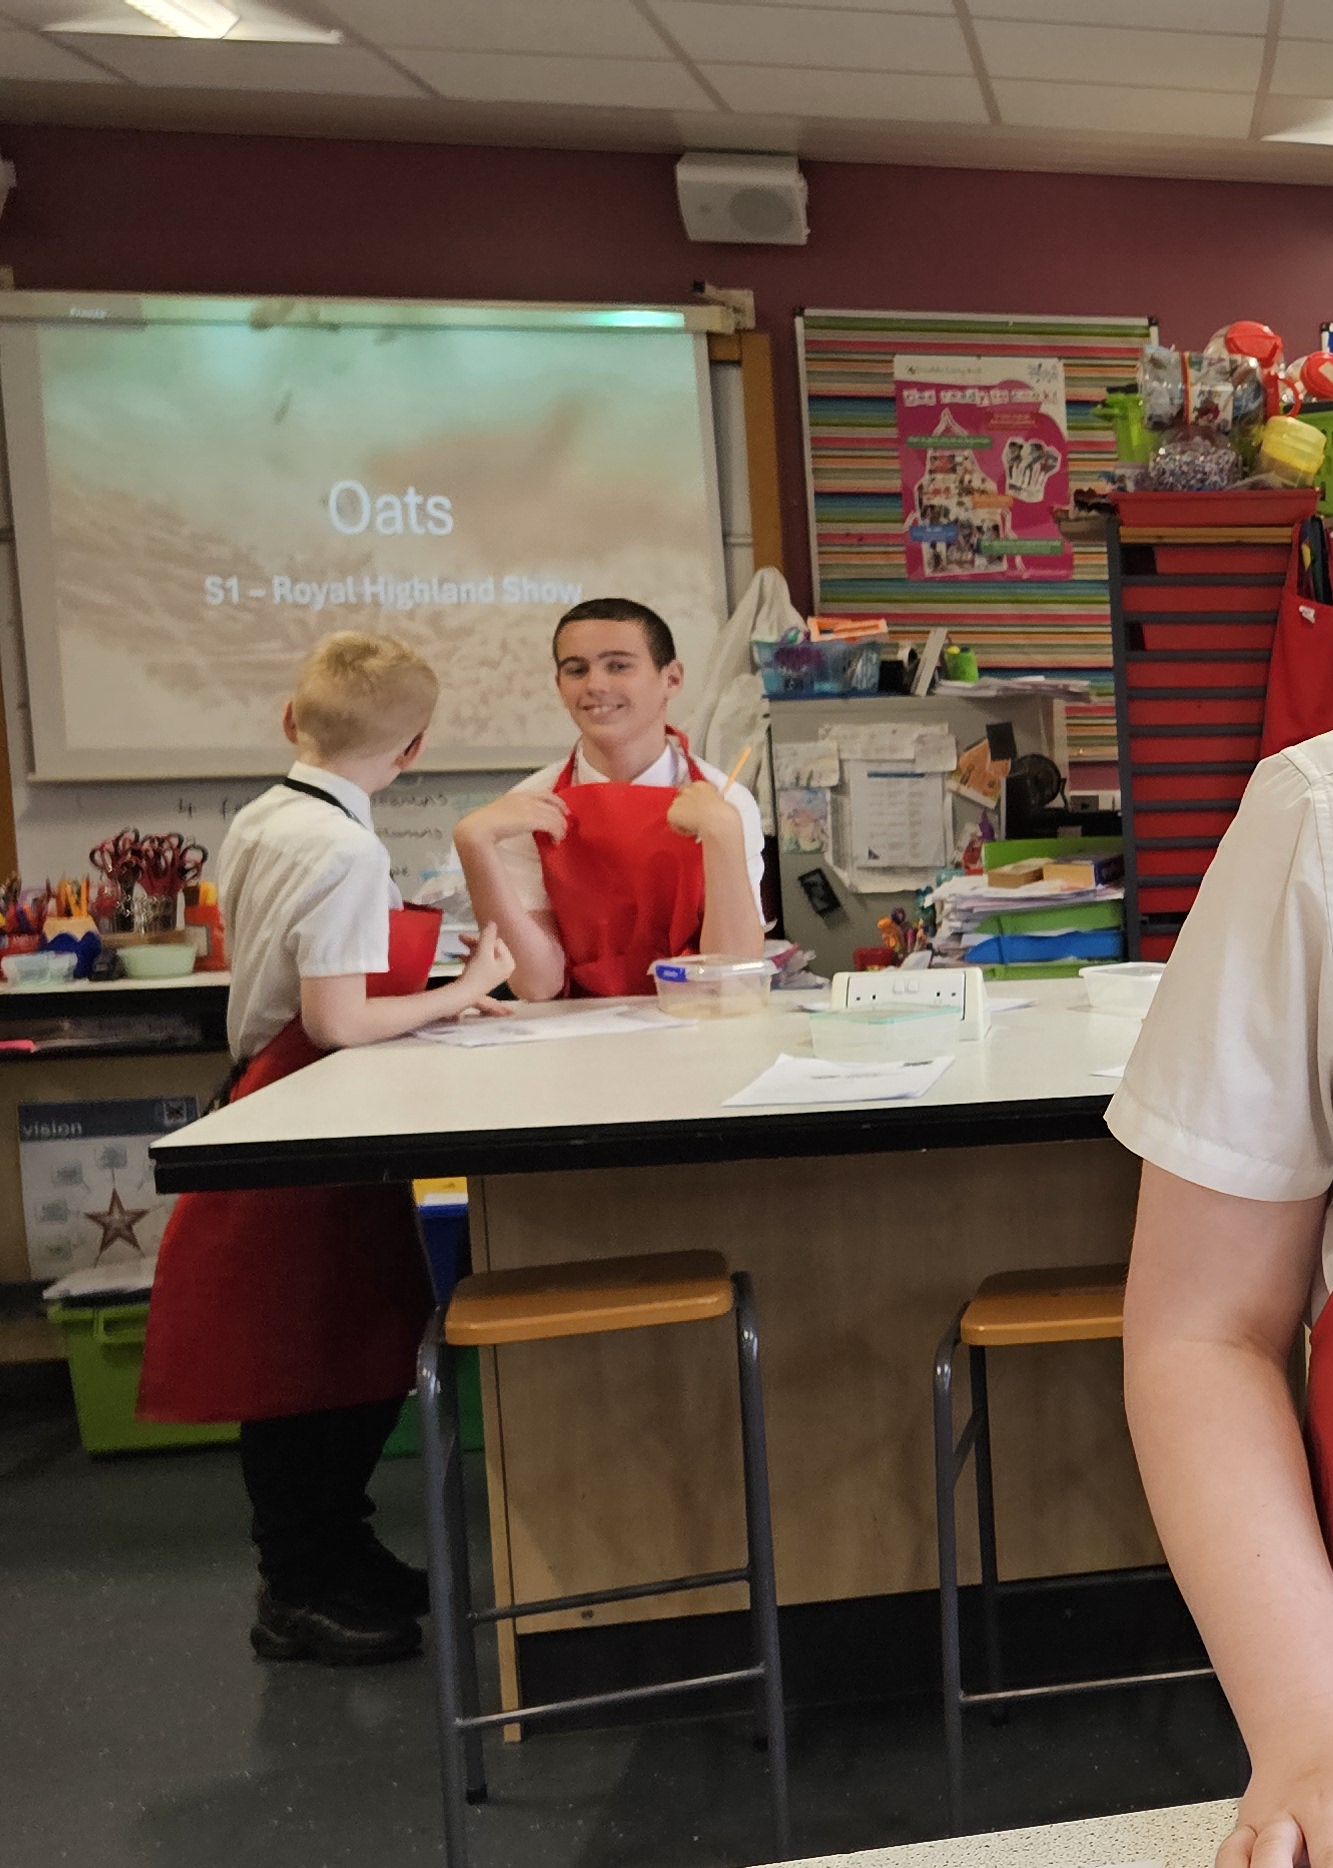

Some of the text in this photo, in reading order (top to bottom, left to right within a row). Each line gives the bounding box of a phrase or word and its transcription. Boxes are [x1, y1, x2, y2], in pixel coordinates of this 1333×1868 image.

[328, 480, 454, 536] Oats
[204, 576, 240, 605] S1
[272, 575, 358, 611] Royal
[362, 575, 495, 611] Highland
[501, 575, 582, 605] Show
